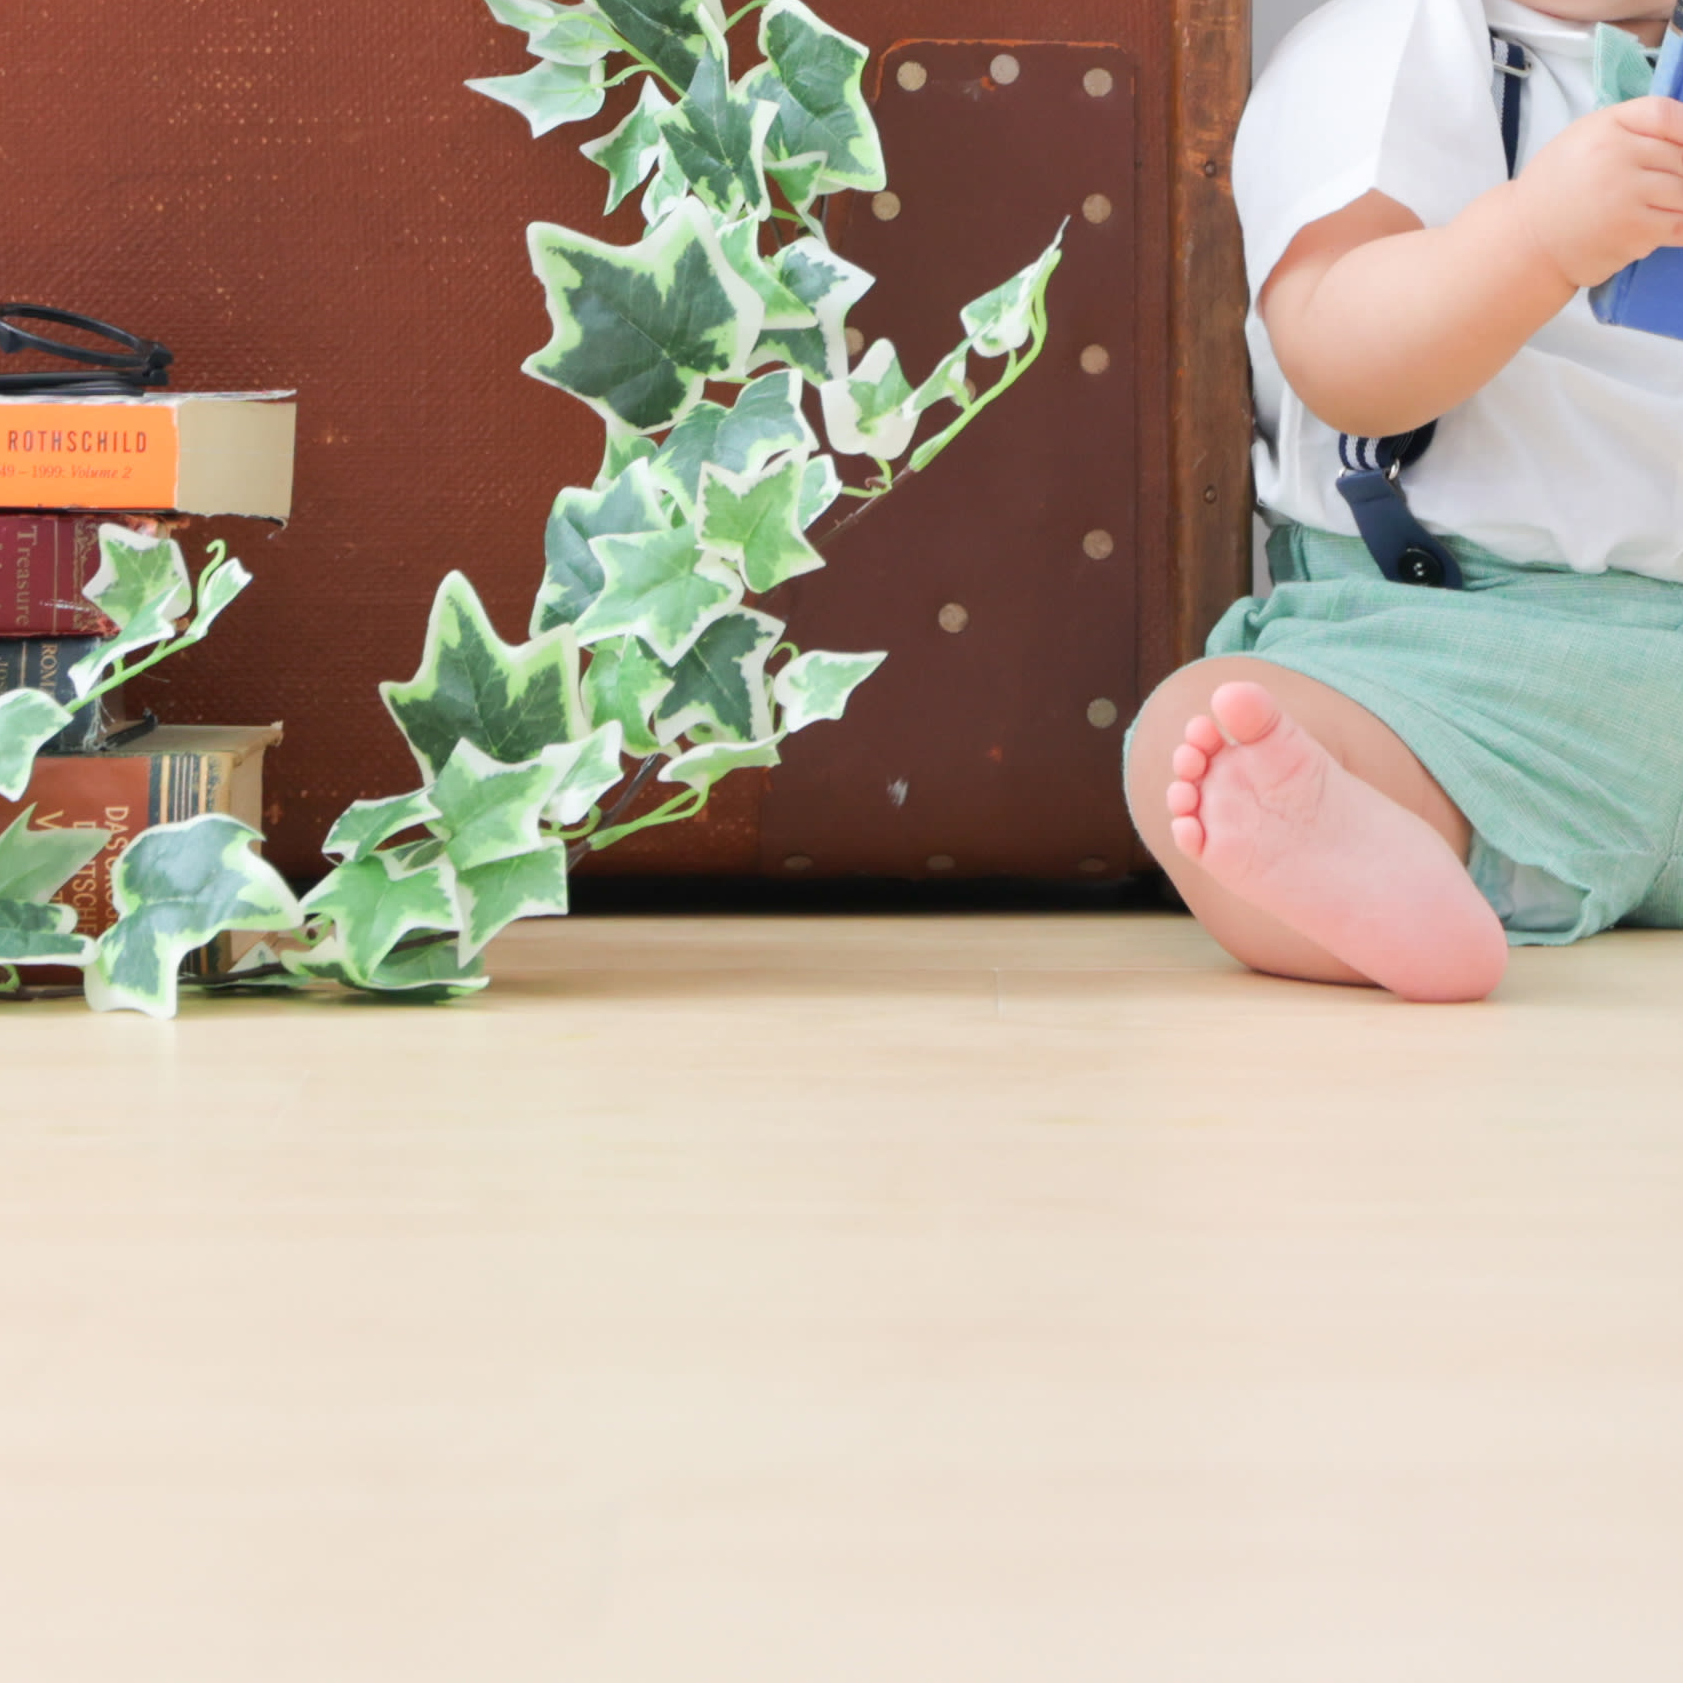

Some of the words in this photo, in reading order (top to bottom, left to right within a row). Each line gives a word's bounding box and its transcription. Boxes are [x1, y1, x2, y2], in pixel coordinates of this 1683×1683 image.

[8, 430, 147, 453] ROTHSCHILD
[31, 463, 67, 479] 1999:
[70, 464, 117, 479] Volume
[121, 465, 132, 479] 2
[17, 524, 38, 626] Treasure
[40, 642, 58, 694] ROM
[105, 806, 130, 851] DAS
